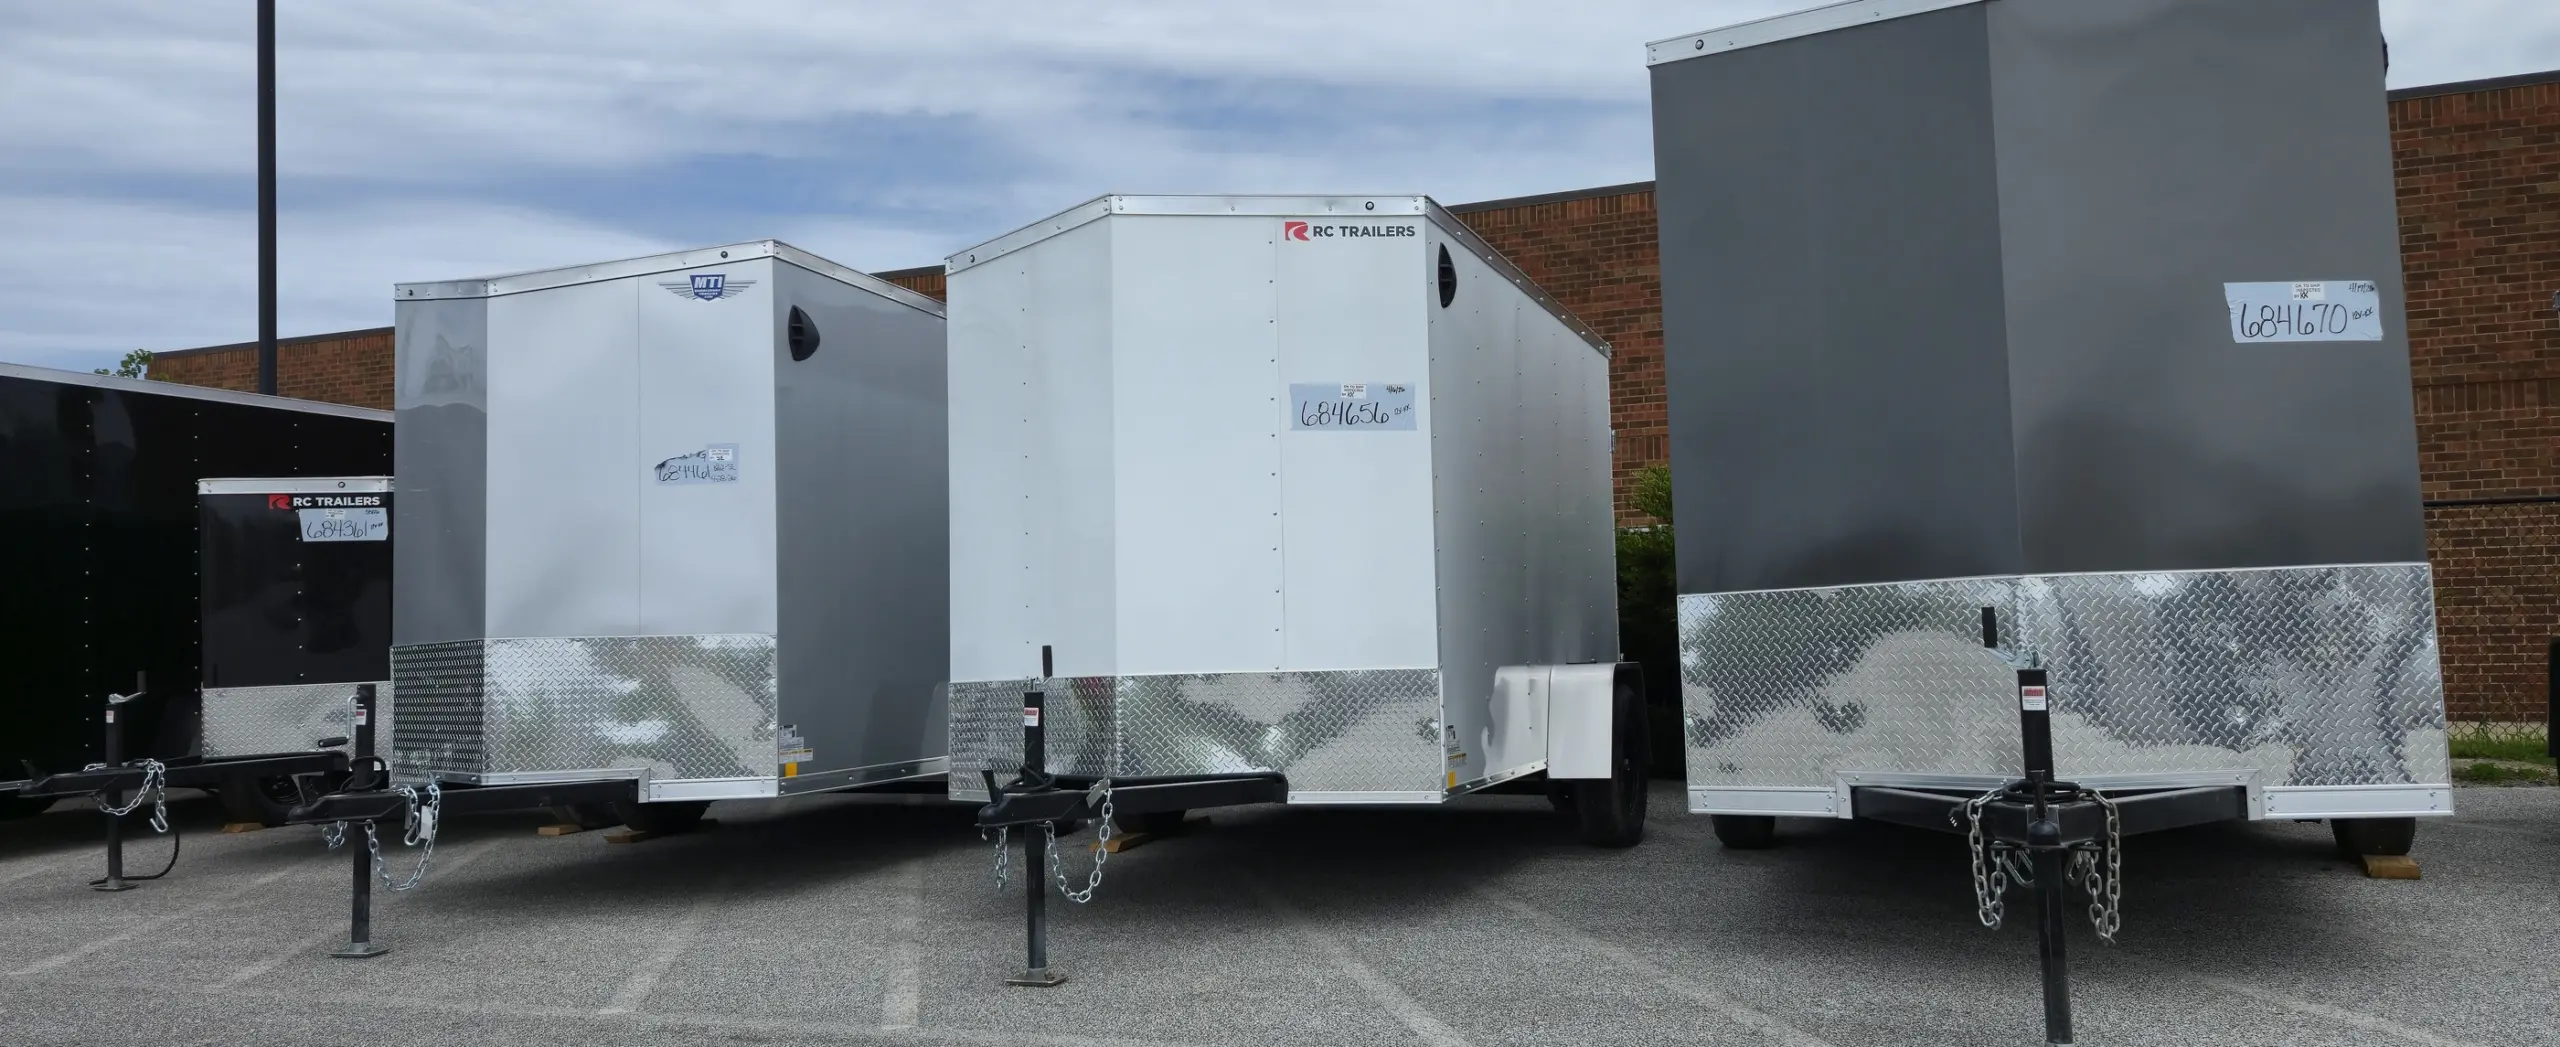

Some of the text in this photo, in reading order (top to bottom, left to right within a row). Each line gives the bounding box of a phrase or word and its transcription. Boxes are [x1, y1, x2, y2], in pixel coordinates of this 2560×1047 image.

[1312, 225, 1416, 238] RC TRAILERS
[694, 276, 722, 288] MTI
[2241, 303, 2348, 337] 684670
[1301, 400, 1390, 426] 684656
[292, 496, 381, 507] RC TRAILERS
[306, 519, 368, 539] 684361
